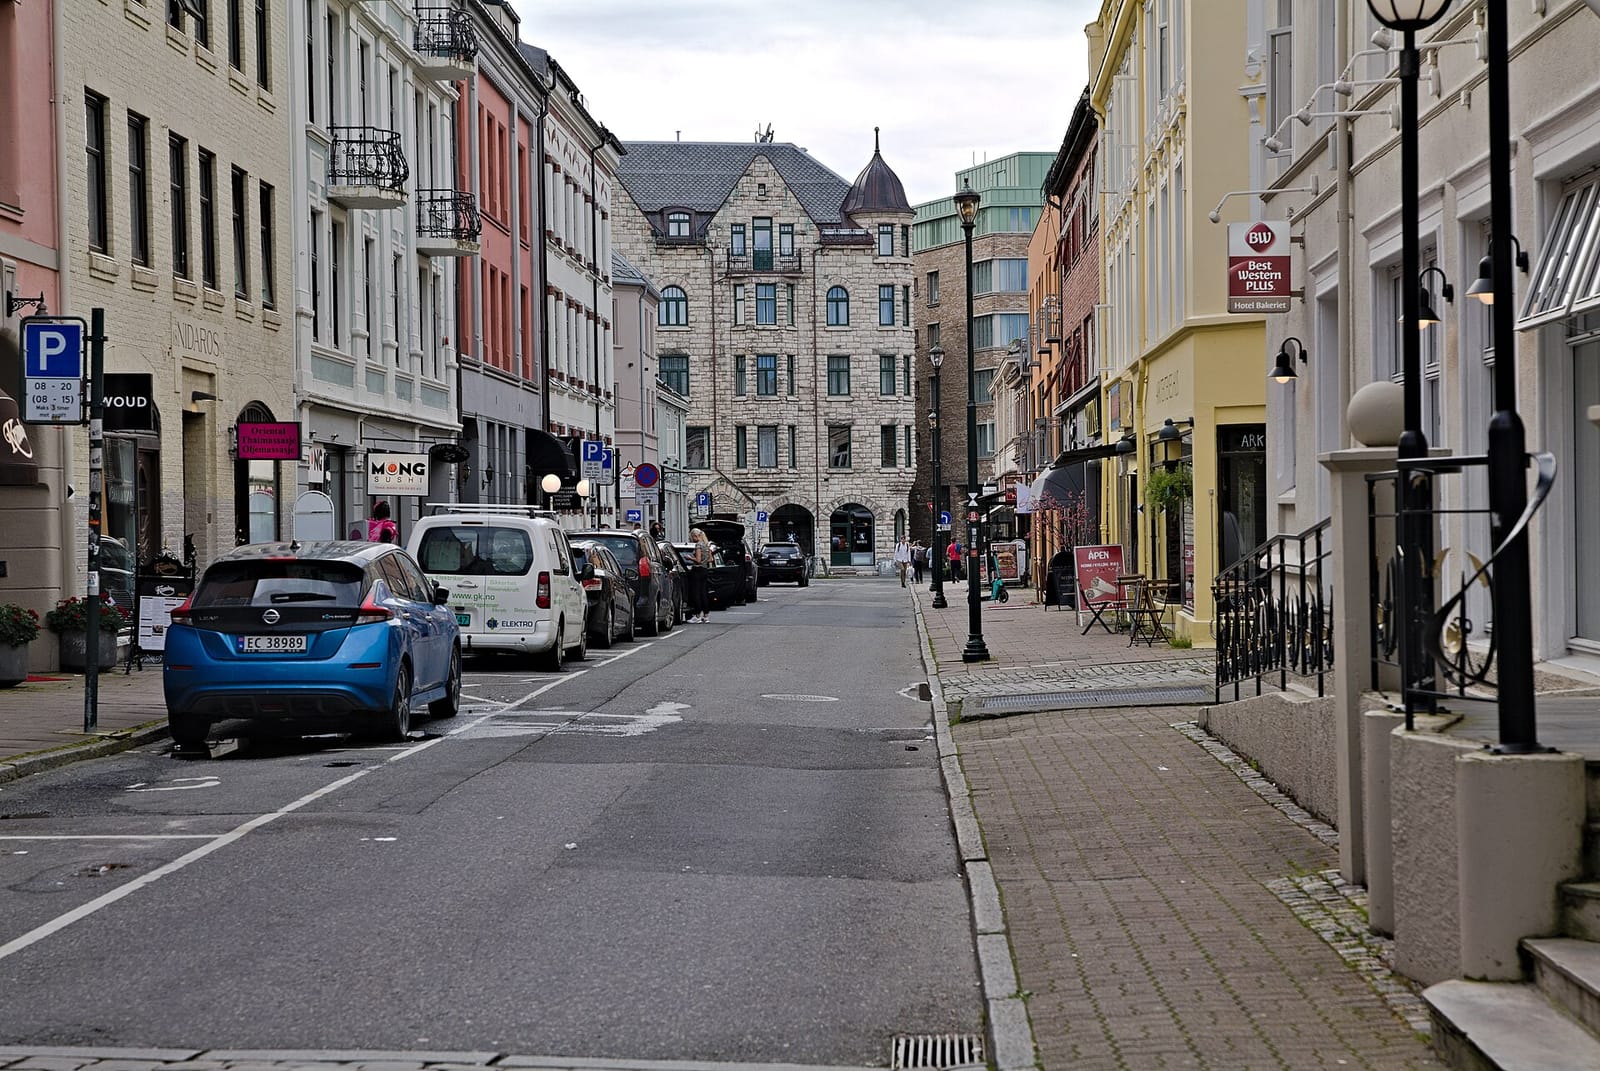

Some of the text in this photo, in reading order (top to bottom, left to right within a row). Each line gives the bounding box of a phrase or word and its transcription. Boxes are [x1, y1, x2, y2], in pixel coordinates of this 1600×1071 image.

[1249, 231, 1272, 244] BW
[1248, 261, 1272, 270] Best
[1238, 270, 1281, 280] Western
[1234, 301, 1287, 309] Hotel Bakeriet
[177, 321, 219, 357] NIDAROS
[39, 331, 67, 371] P
[35, 382, 46, 390] 08
[61, 383, 72, 391] 20
[32, 395, 48, 404] (08
[62, 395, 74, 404] 15)
[102, 396, 147, 408] WOUD
[250, 427, 286, 436] Oriental
[1241, 434, 1265, 447] ARK
[587, 443, 599, 460] P
[371, 461, 426, 476] MONG
[452, 592, 496, 602] www.gk.no
[501, 620, 533, 628] ELEKTRO
[247, 637, 303, 648] EC 38989
